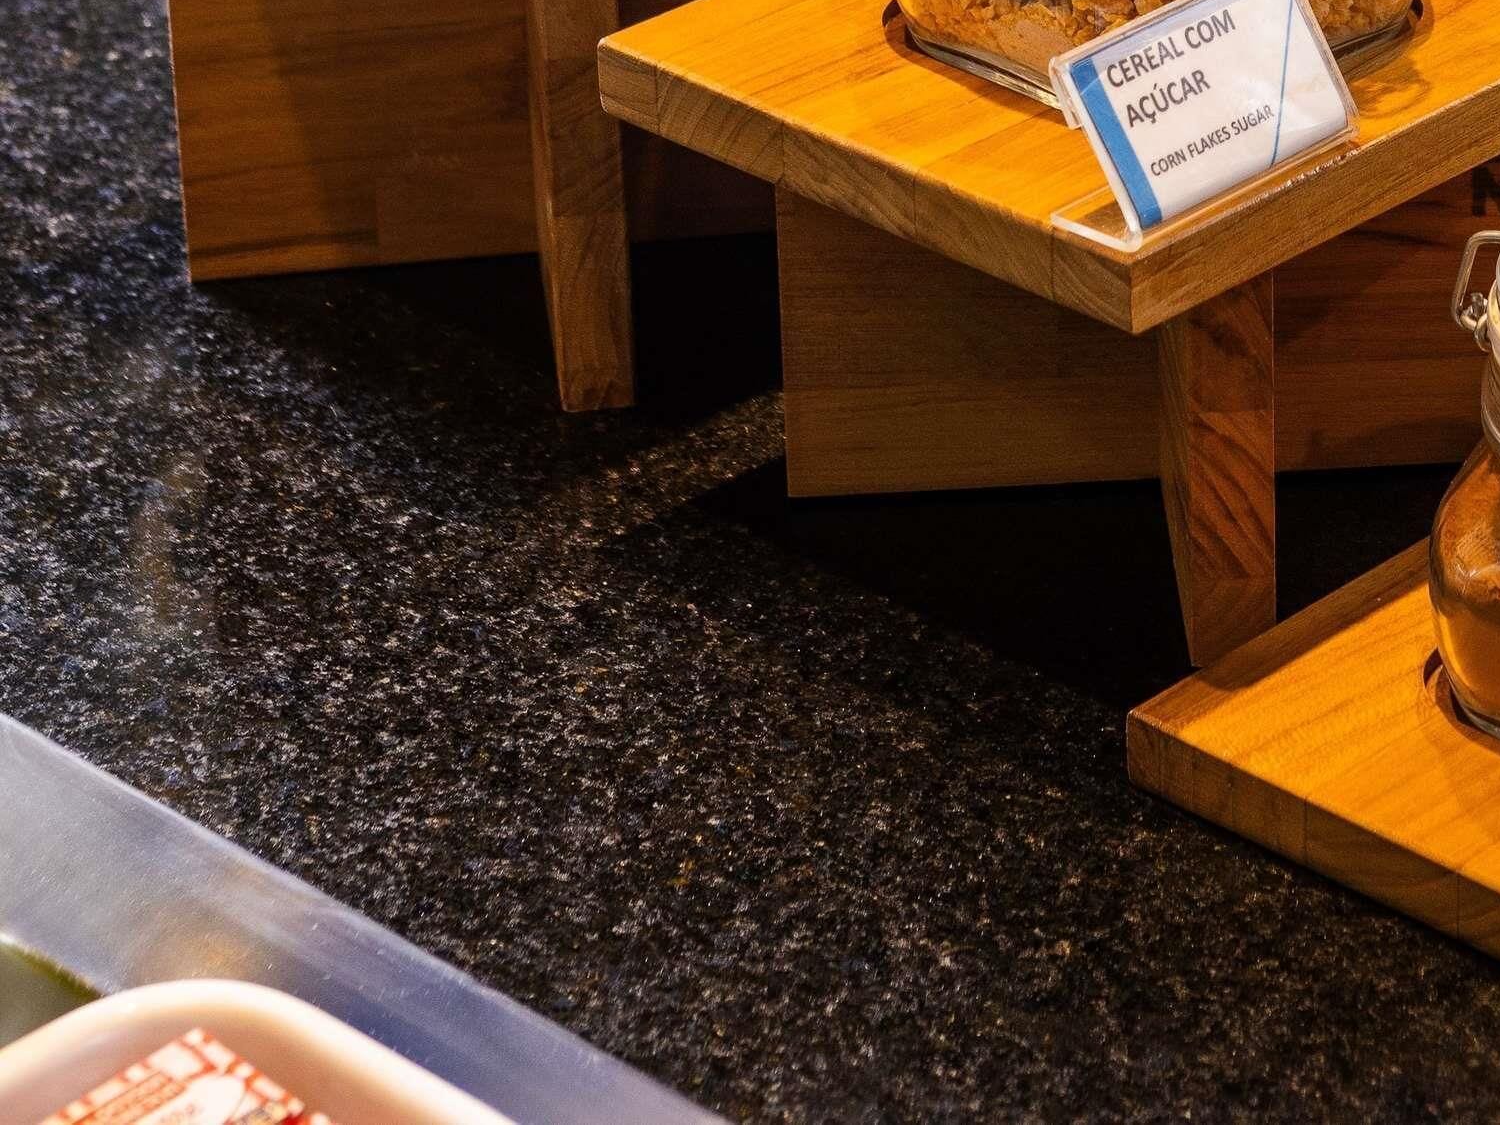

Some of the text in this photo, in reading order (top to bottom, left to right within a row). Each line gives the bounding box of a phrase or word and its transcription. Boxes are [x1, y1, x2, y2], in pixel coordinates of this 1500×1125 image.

[1106, 9, 1236, 88] CEREAL COM
[1125, 69, 1212, 128] AÇÚCAR
[1150, 104, 1275, 176] CORN FLAKES SUGAR
